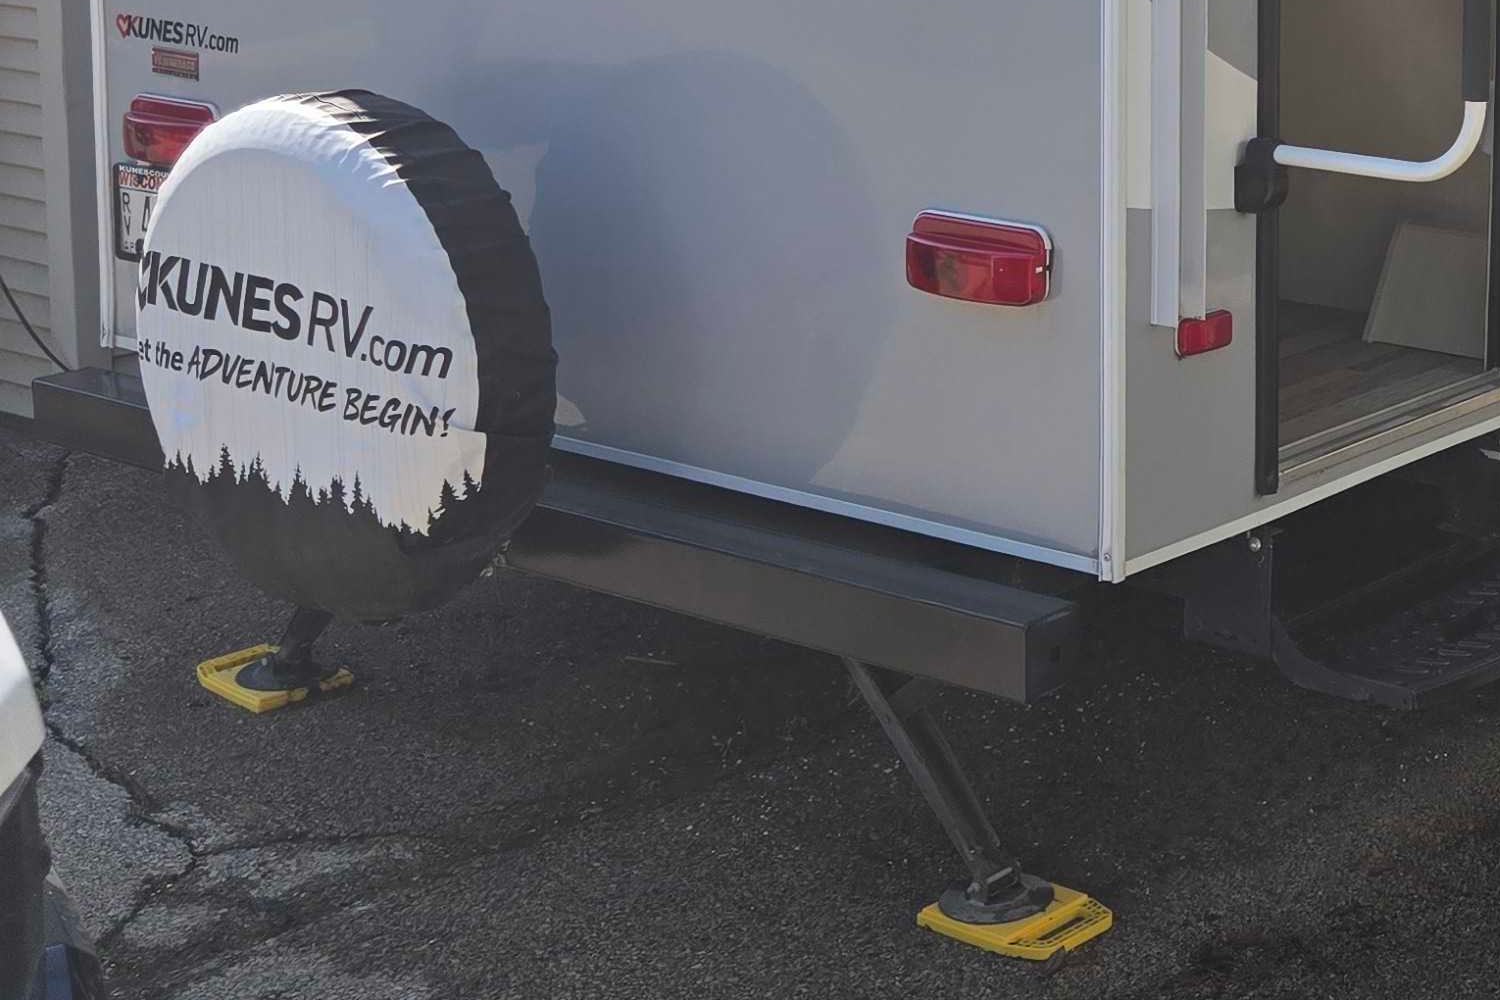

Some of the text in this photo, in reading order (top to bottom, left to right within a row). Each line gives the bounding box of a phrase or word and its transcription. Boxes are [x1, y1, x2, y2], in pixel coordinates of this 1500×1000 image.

[138, 338, 457, 438] et the ADVENTURE BEGIN!
